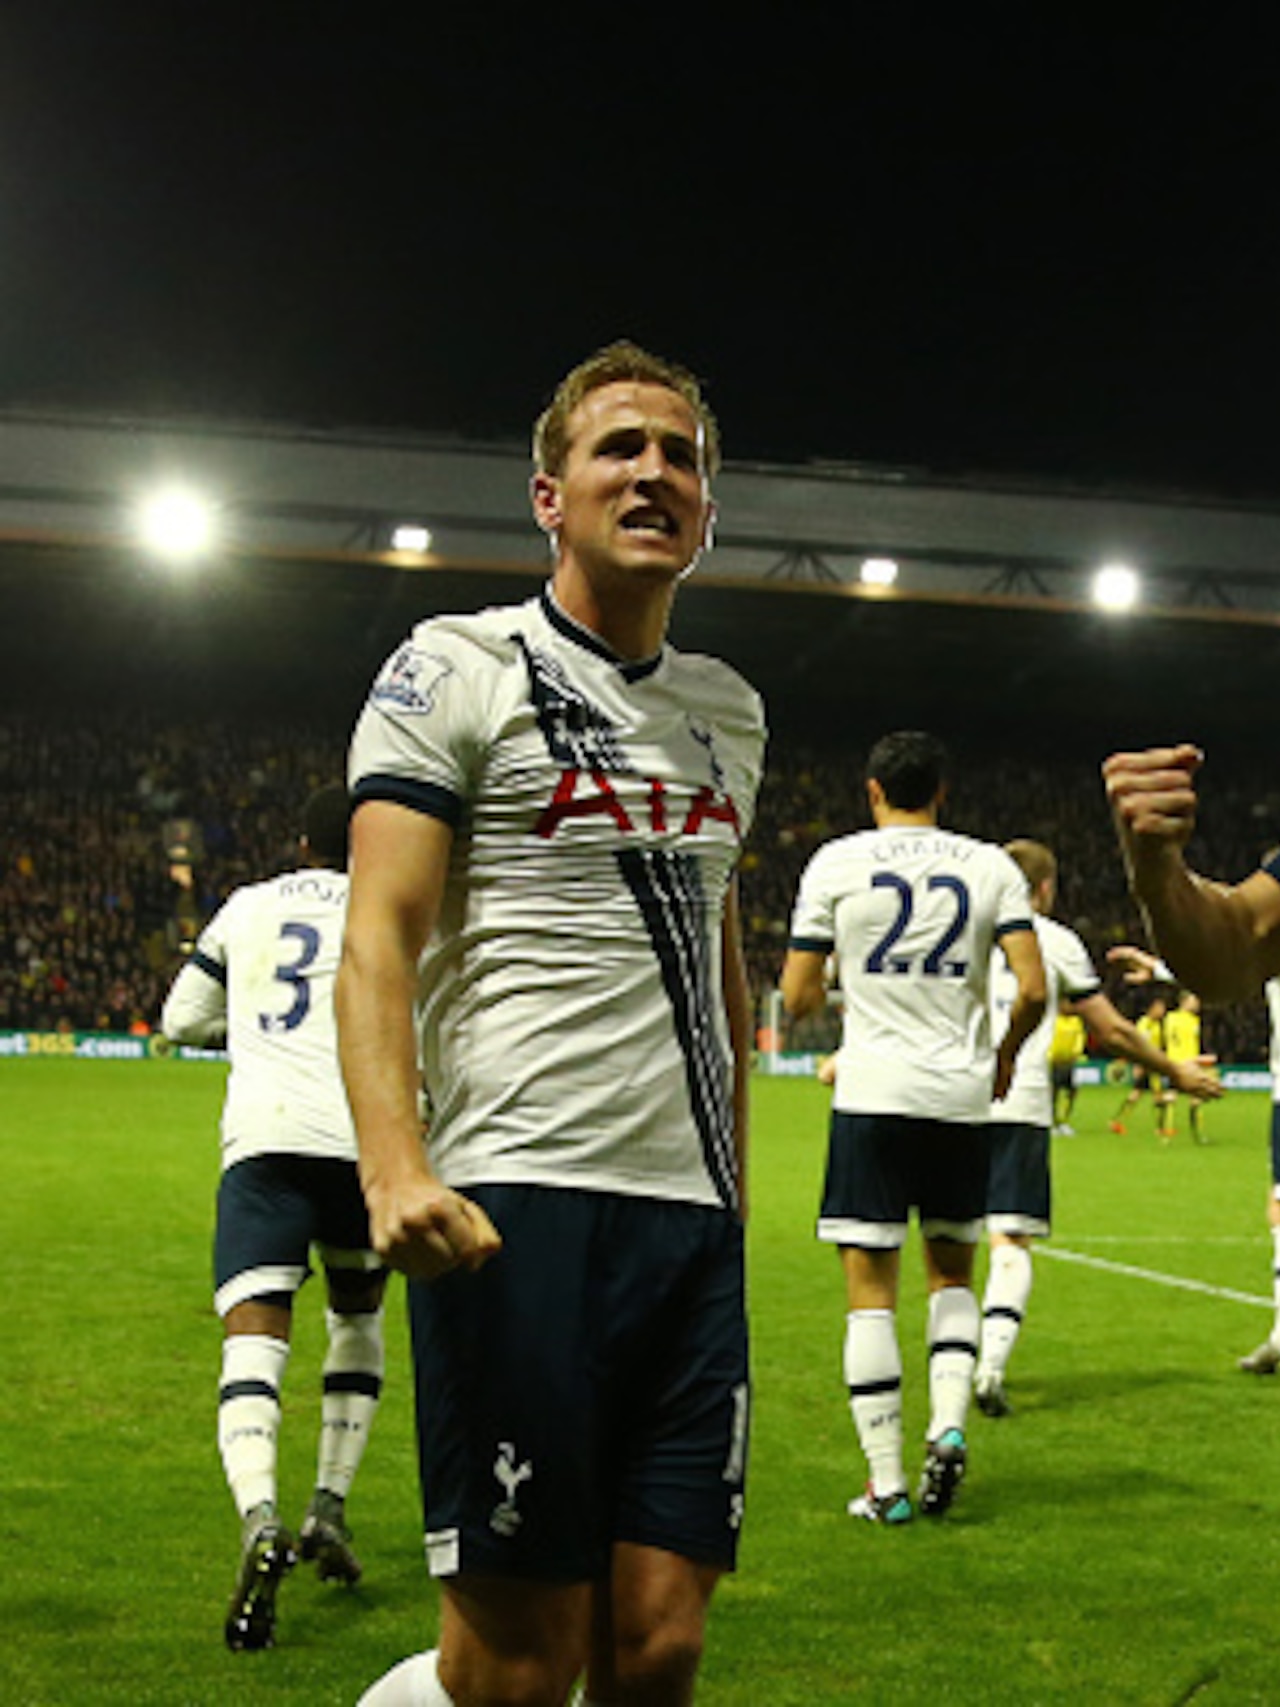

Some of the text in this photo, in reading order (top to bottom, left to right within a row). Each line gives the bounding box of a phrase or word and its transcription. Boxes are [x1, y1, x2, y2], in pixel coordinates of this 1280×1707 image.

[534, 770, 742, 839] AIA
[864, 871, 970, 978] 22
[258, 922, 321, 1032] 3
[0, 1033, 143, 1057] et365.com
